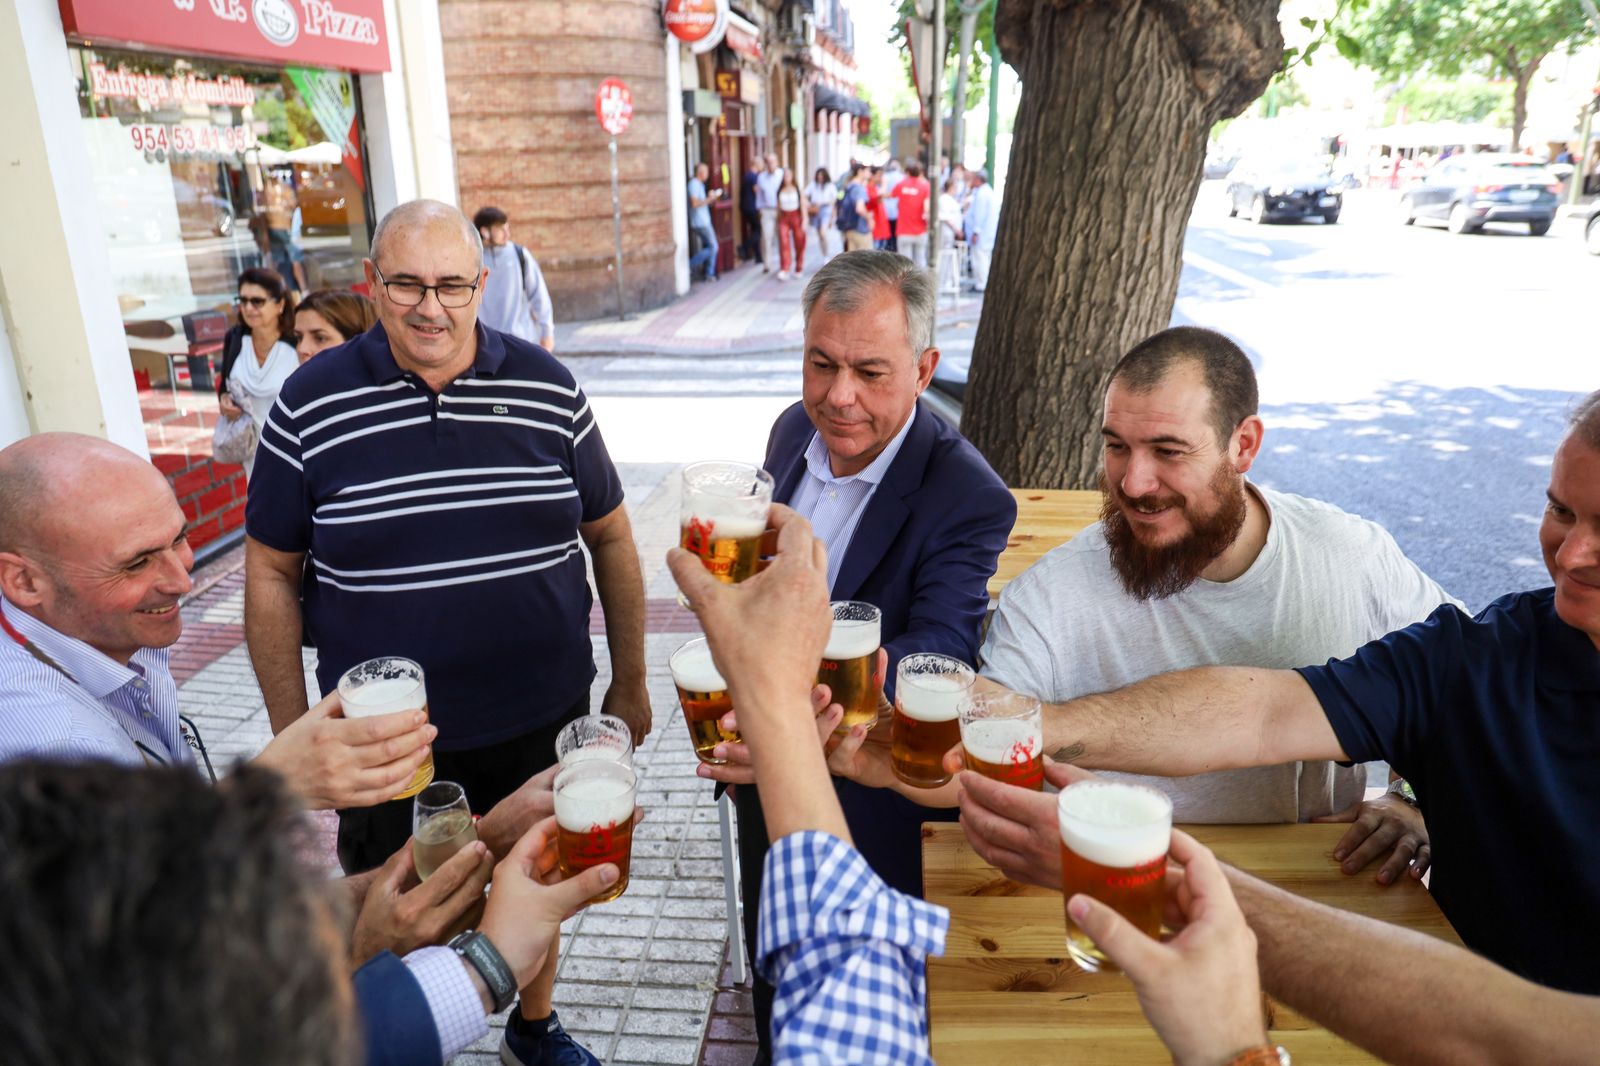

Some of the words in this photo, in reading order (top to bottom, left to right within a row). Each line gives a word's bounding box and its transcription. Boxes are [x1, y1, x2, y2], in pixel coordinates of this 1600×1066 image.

[302, 0, 379, 46] Pizza
[91, 63, 169, 109] Entrega
[186, 73, 255, 107] domicilio
[131, 127, 168, 151] 954
[173, 127, 196, 151] 53
[202, 128, 220, 151] 41
[224, 128, 246, 152] 95
